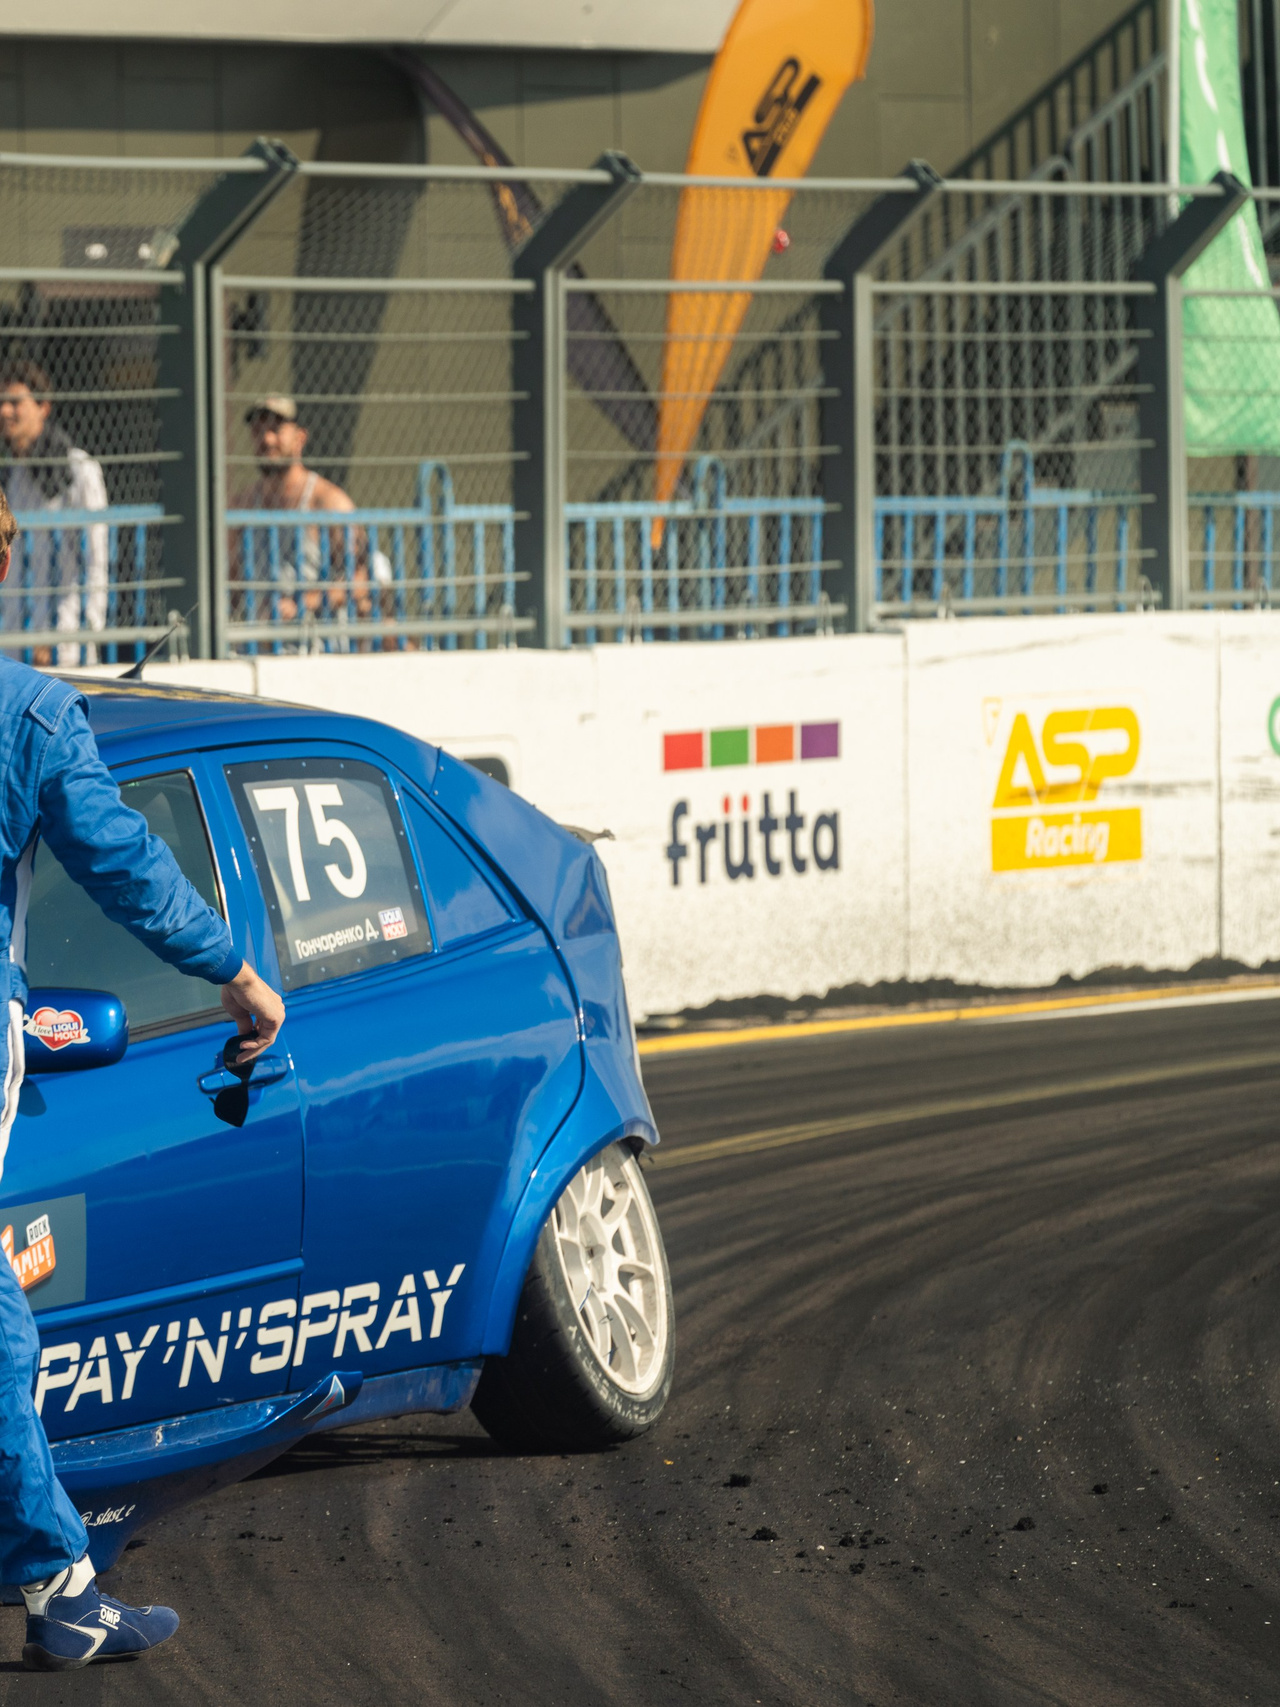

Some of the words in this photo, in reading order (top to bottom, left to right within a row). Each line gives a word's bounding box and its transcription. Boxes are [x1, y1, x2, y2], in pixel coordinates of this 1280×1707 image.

[992, 706, 1140, 808] ASP
[252, 784, 367, 902] 75
[666, 790, 840, 887] frütta
[1025, 812, 1110, 863] Racing
[380, 909, 404, 925] LIQUI
[294, 923, 364, 960] Гончаренко
[365, 918, 380, 942] Д.
[382, 921, 407, 940] MOLY
[37, 1026, 52, 1035] love
[52, 1022, 80, 1033] LIQUI
[54, 1031, 80, 1041] MOLY
[28, 1219, 48, 1242] ROCK
[12, 1238, 51, 1277] AMILY
[100, 1607, 121, 1626] OMP
